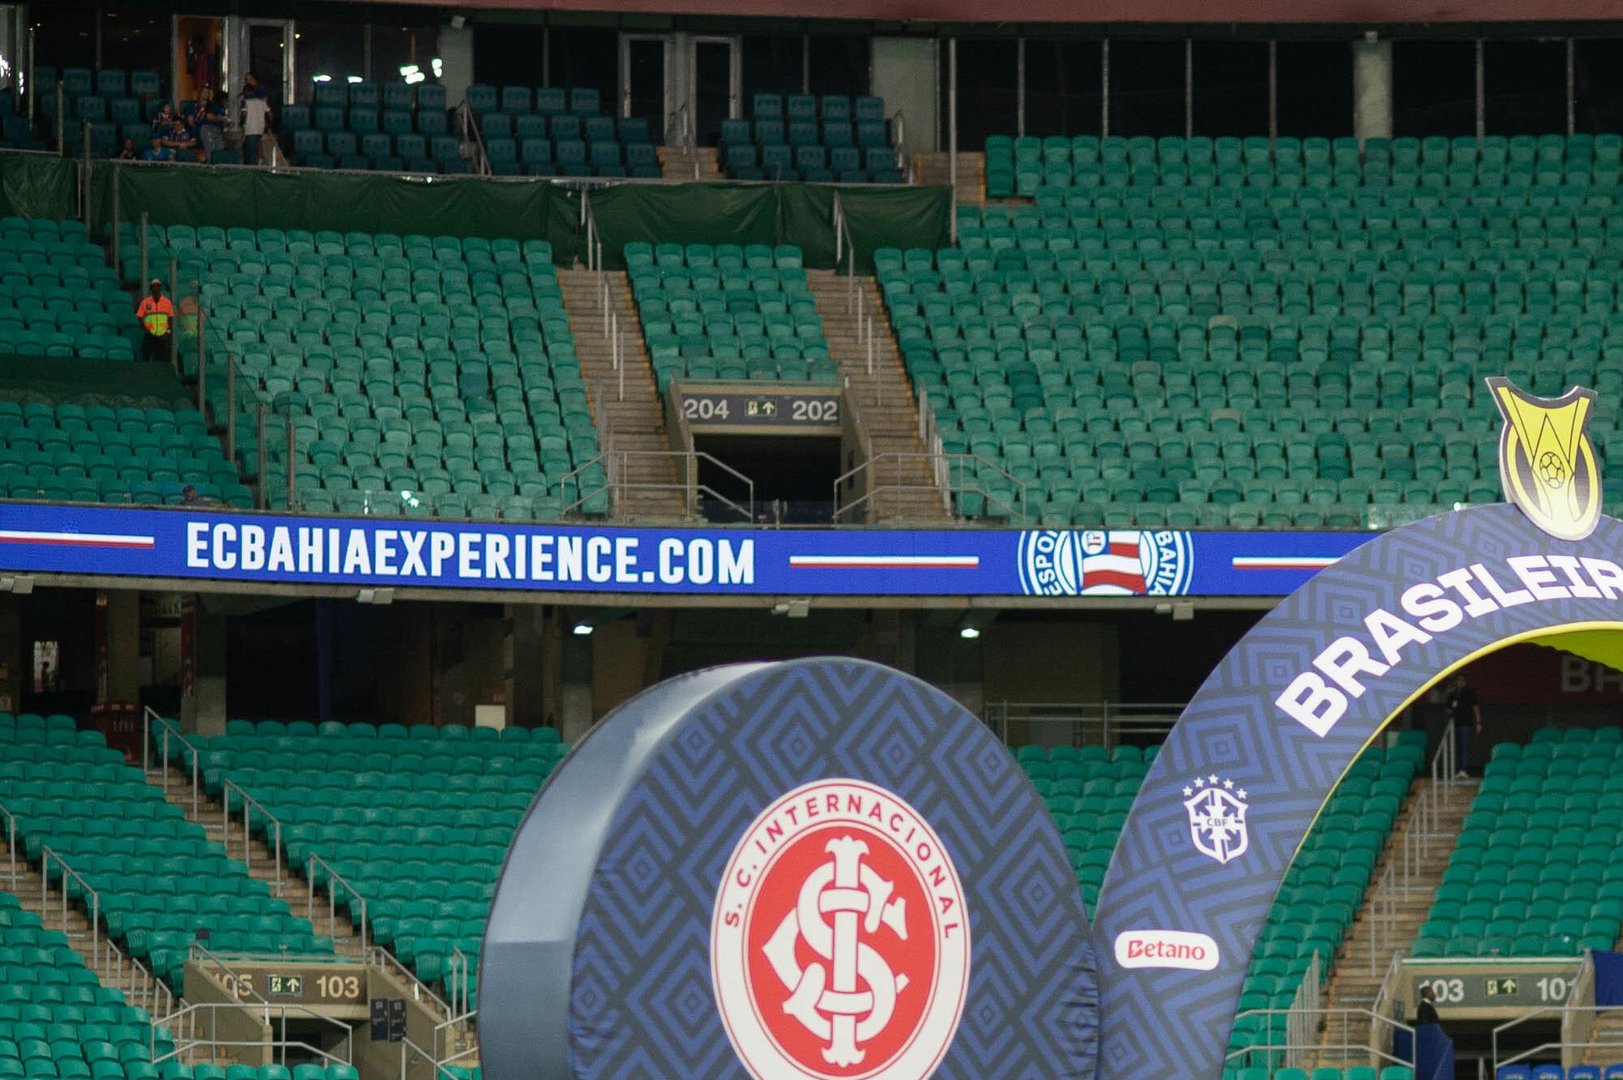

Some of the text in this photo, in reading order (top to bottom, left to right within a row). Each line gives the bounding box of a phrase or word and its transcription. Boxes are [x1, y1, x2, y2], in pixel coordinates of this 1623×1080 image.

[684, 399, 837, 421] 204 202
[187, 521, 755, 584] ECBAHIAEXPERIENCE.COM
[1206, 817, 1229, 827] CBF
[755, 793, 959, 939] INTERNACIONAL
[1127, 939, 1206, 961] Betano
[316, 975, 360, 998] 103
